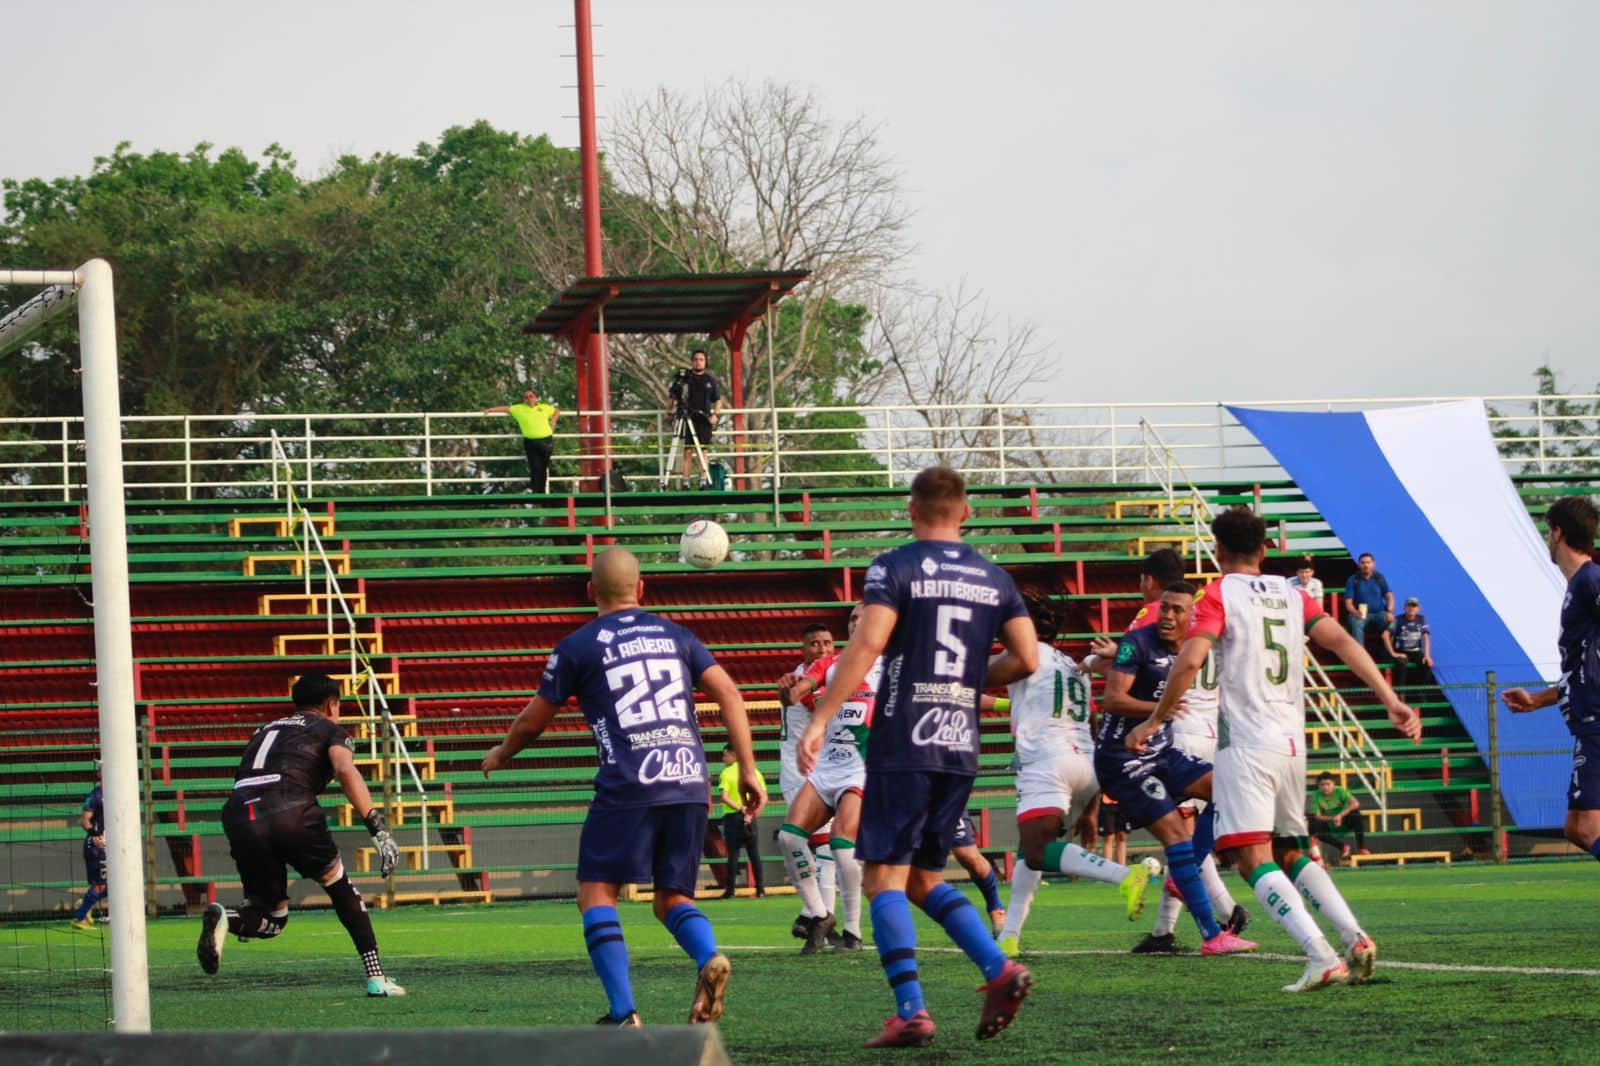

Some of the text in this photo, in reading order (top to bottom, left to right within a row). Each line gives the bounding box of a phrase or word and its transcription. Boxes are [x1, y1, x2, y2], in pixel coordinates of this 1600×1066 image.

[602, 636, 677, 665] J. AGÜERO
[934, 604, 974, 678] 5
[1263, 616, 1288, 686] 5
[605, 658, 687, 730] 22
[1052, 669, 1087, 723] 19
[252, 730, 280, 769] 1
